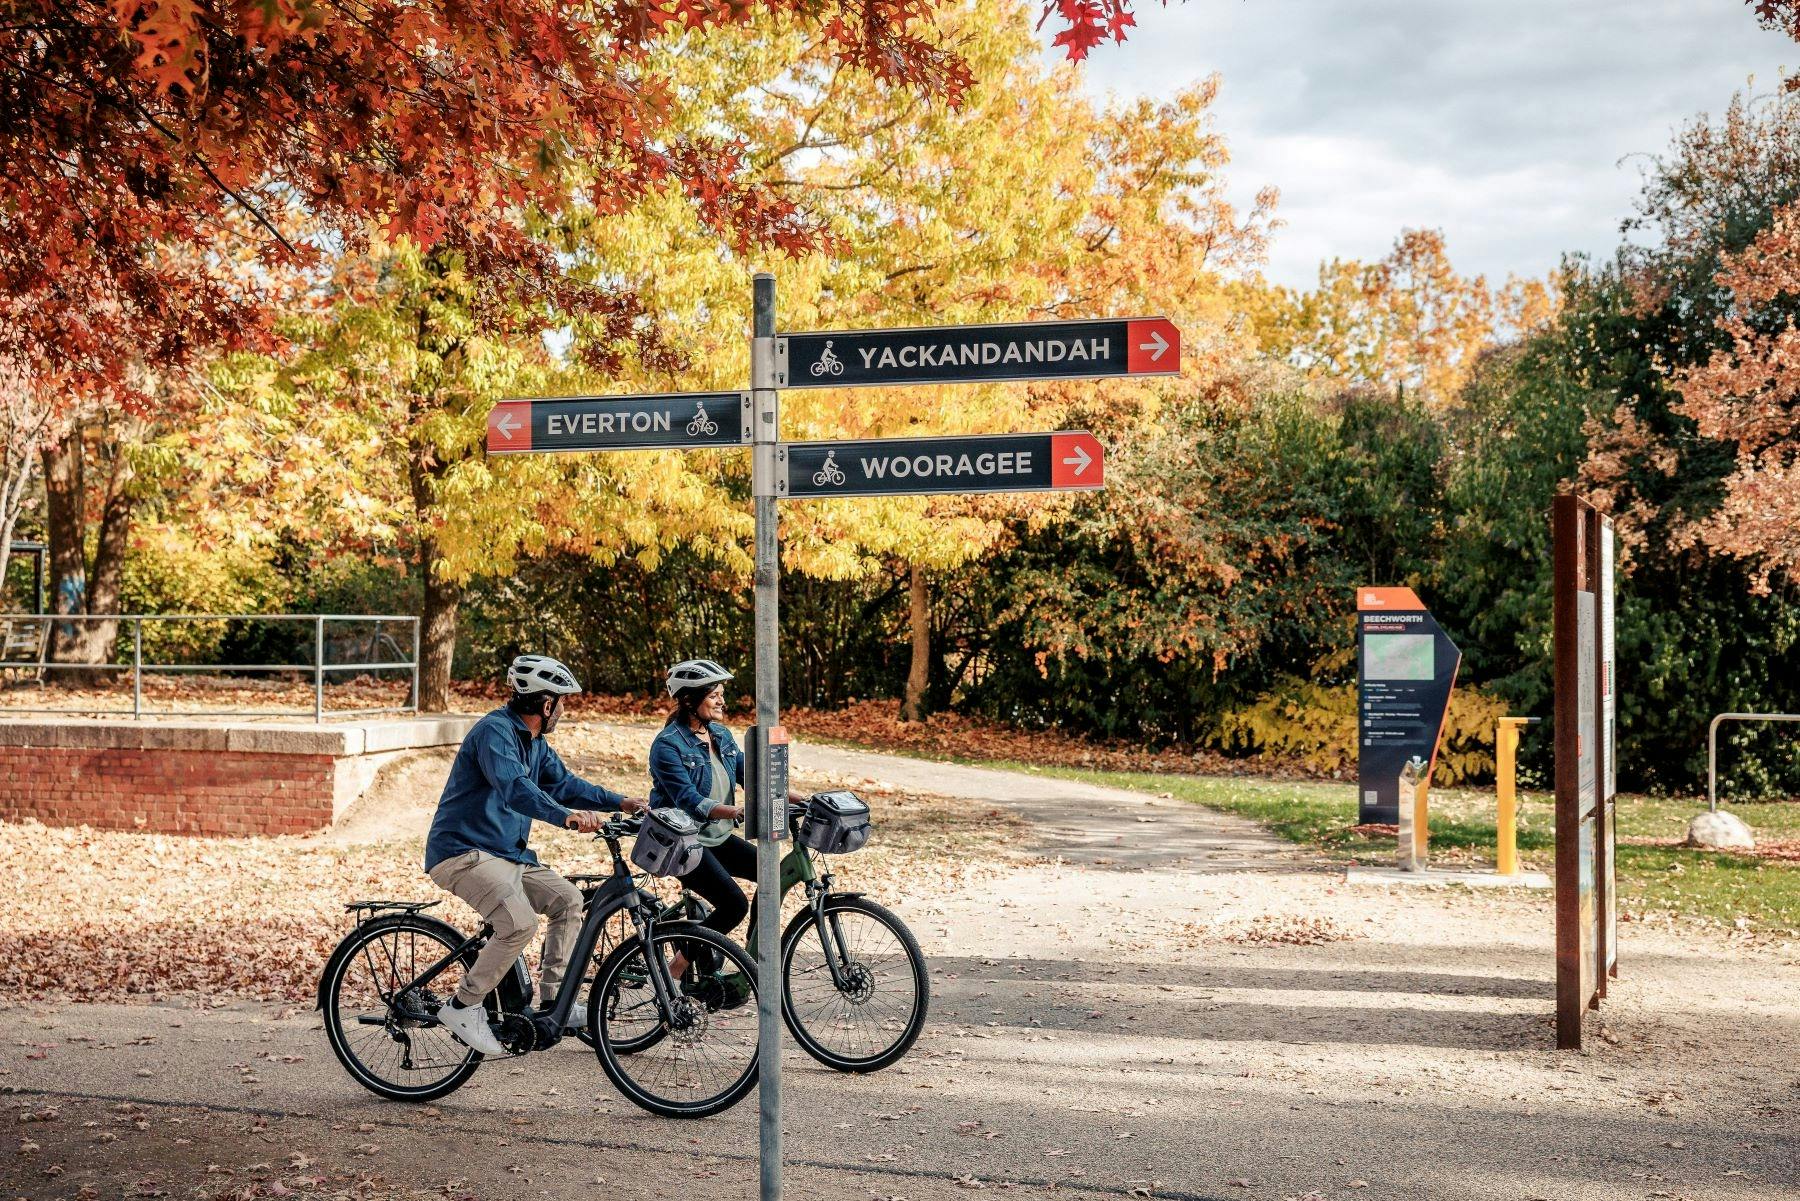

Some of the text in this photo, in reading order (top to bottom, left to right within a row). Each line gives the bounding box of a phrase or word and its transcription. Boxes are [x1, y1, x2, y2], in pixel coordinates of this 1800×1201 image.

[858, 337, 1111, 370] YACKANDANDAH
[546, 410, 671, 435] EVERTON
[861, 450, 1033, 479] WOORAGEE
[1364, 615, 1423, 623] BEECHWORTH
